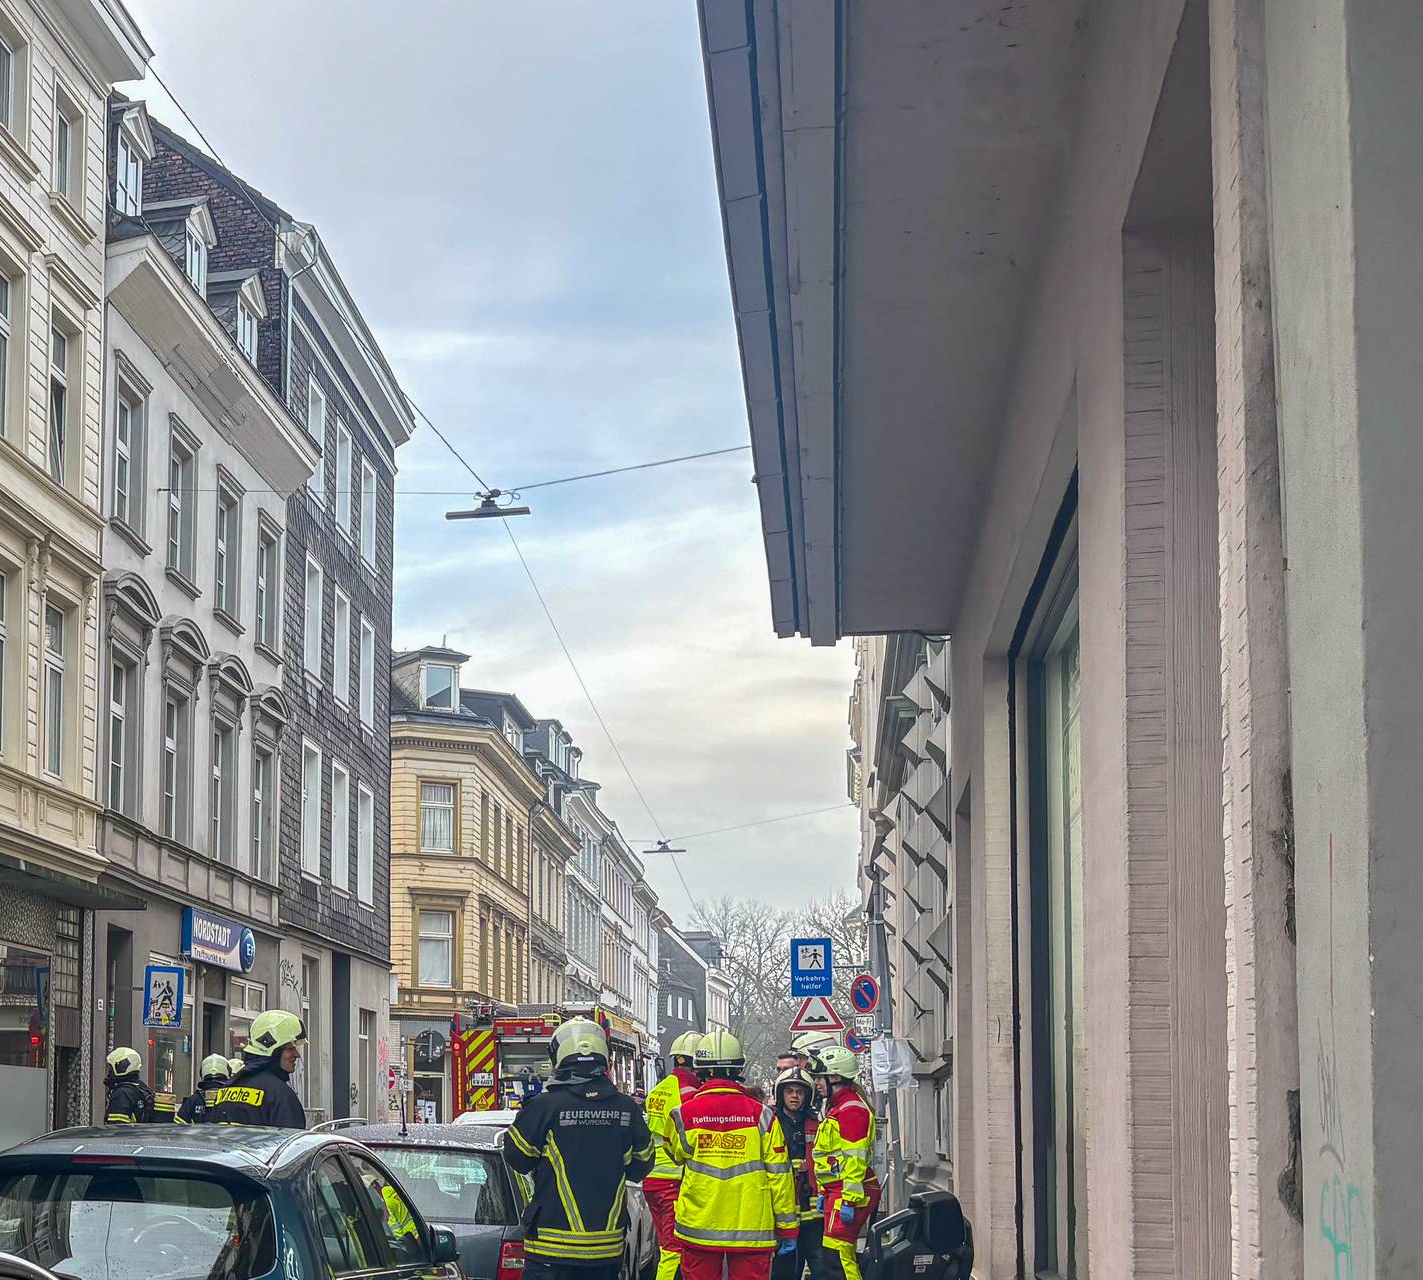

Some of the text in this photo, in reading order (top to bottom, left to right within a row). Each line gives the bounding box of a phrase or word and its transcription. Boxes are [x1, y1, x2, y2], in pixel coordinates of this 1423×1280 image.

[193, 917, 232, 948] NORDSTADT
[255, 1090, 262, 1104] 1
[559, 1110, 620, 1120] FEUERWEHR
[692, 1114, 754, 1124] Rettungsdienst
[711, 1133, 747, 1149] ASB
